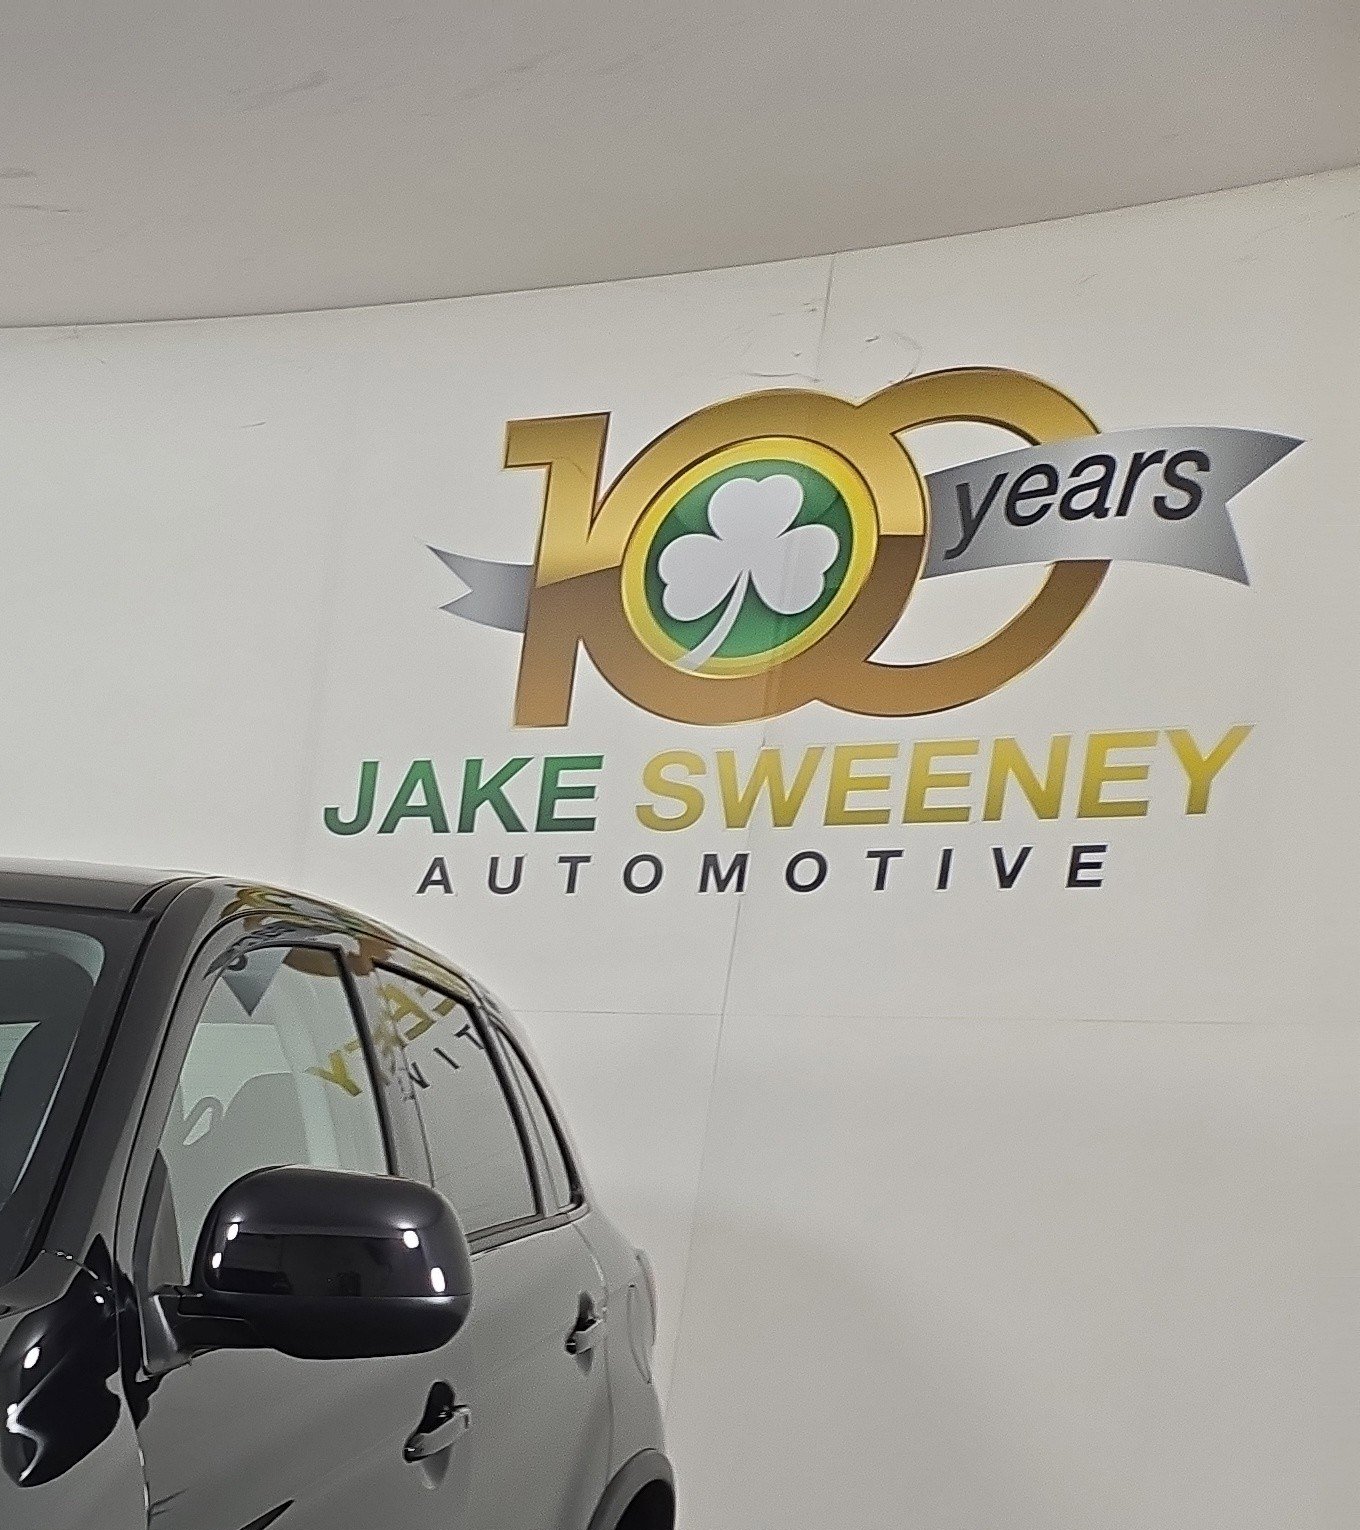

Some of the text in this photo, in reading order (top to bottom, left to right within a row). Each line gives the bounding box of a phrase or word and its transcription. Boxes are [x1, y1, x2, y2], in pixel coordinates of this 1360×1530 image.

[943, 448, 1212, 561] years
[324, 723, 1256, 836] JAKE SWEENEY
[417, 845, 1109, 895] AUTOMOTIVE
